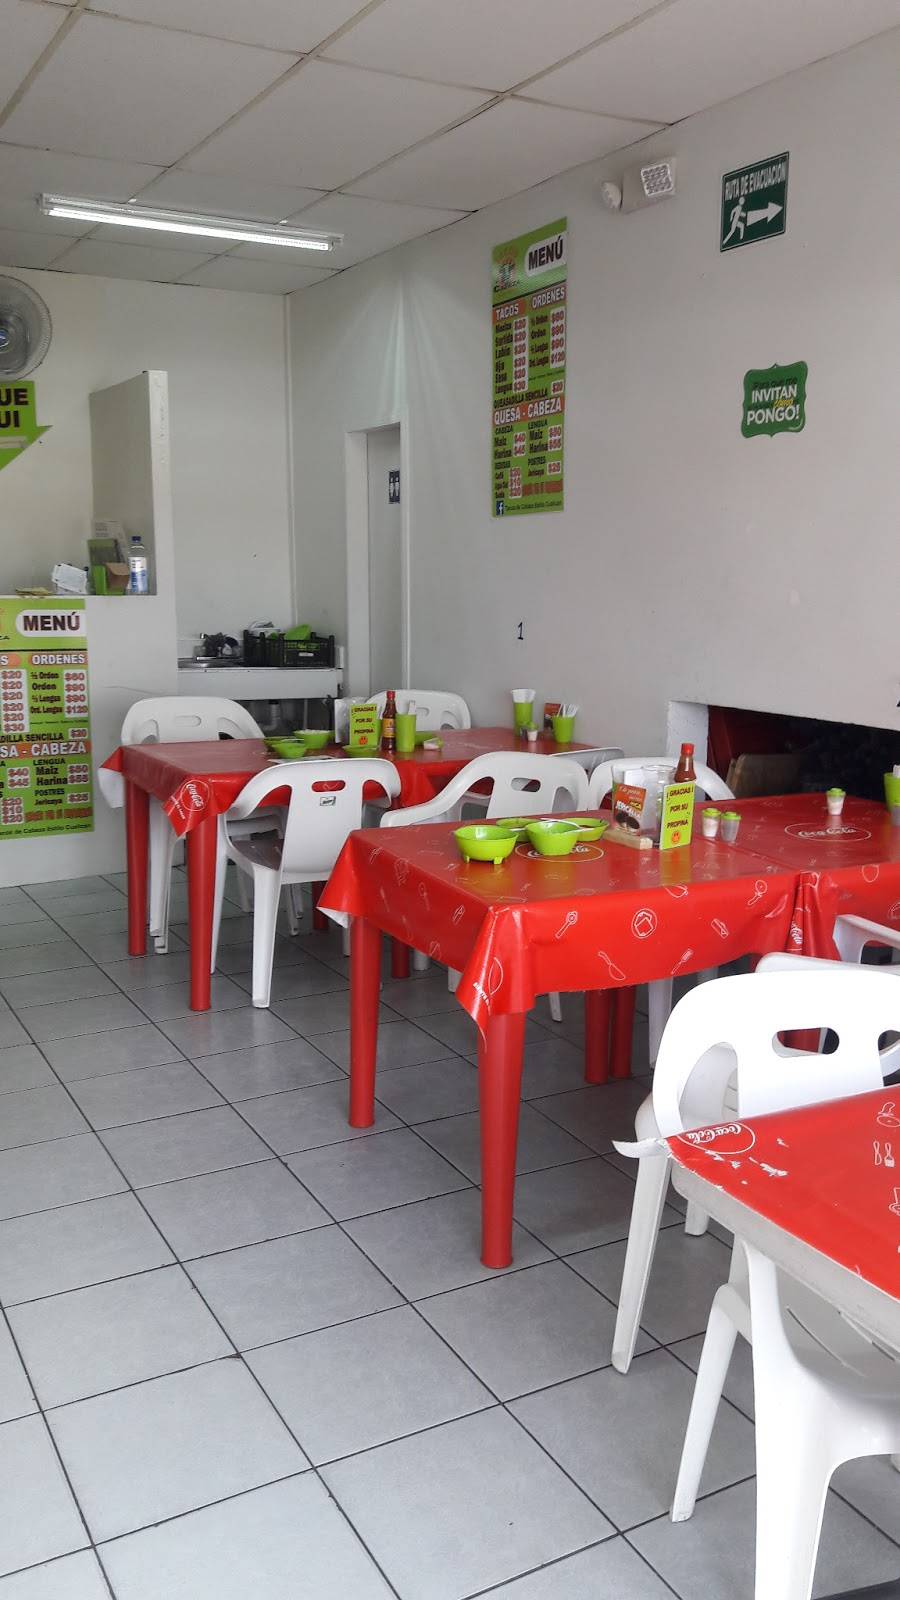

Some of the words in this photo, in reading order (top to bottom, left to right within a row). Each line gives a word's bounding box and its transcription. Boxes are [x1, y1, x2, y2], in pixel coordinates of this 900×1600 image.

[740, 174, 749, 196] DE
[528, 235, 564, 271] MENÚ
[531, 287, 566, 309] ORDENES
[495, 303, 520, 321] TACOS
[752, 384, 798, 404] INVITAN
[494, 407, 521, 425] QUESA
[527, 397, 562, 418] CABEZA
[747, 404, 800, 426] PONGO!
[23, 611, 80, 631] MENÚ
[517, 621, 524, 641] 1
[32, 654, 85, 665] ORDENES
[1, 671, 22, 680] $20
[2, 680, 22, 690] $20
[32, 683, 57, 691] Orden
[2, 691, 23, 701] $20
[3, 703, 24, 712] $20
[3, 713, 24, 722] $20
[25, 733, 65, 742] SENCILLA
[31, 741, 87, 756] CABEZA
[33, 758, 66, 766] LENGUA
[36, 777, 68, 786] Harina
[34, 788, 65, 796] POSTRES
[669, 804, 681, 813] POR
[680, 803, 688, 811] SU
[666, 819, 689, 829] PROPINA
